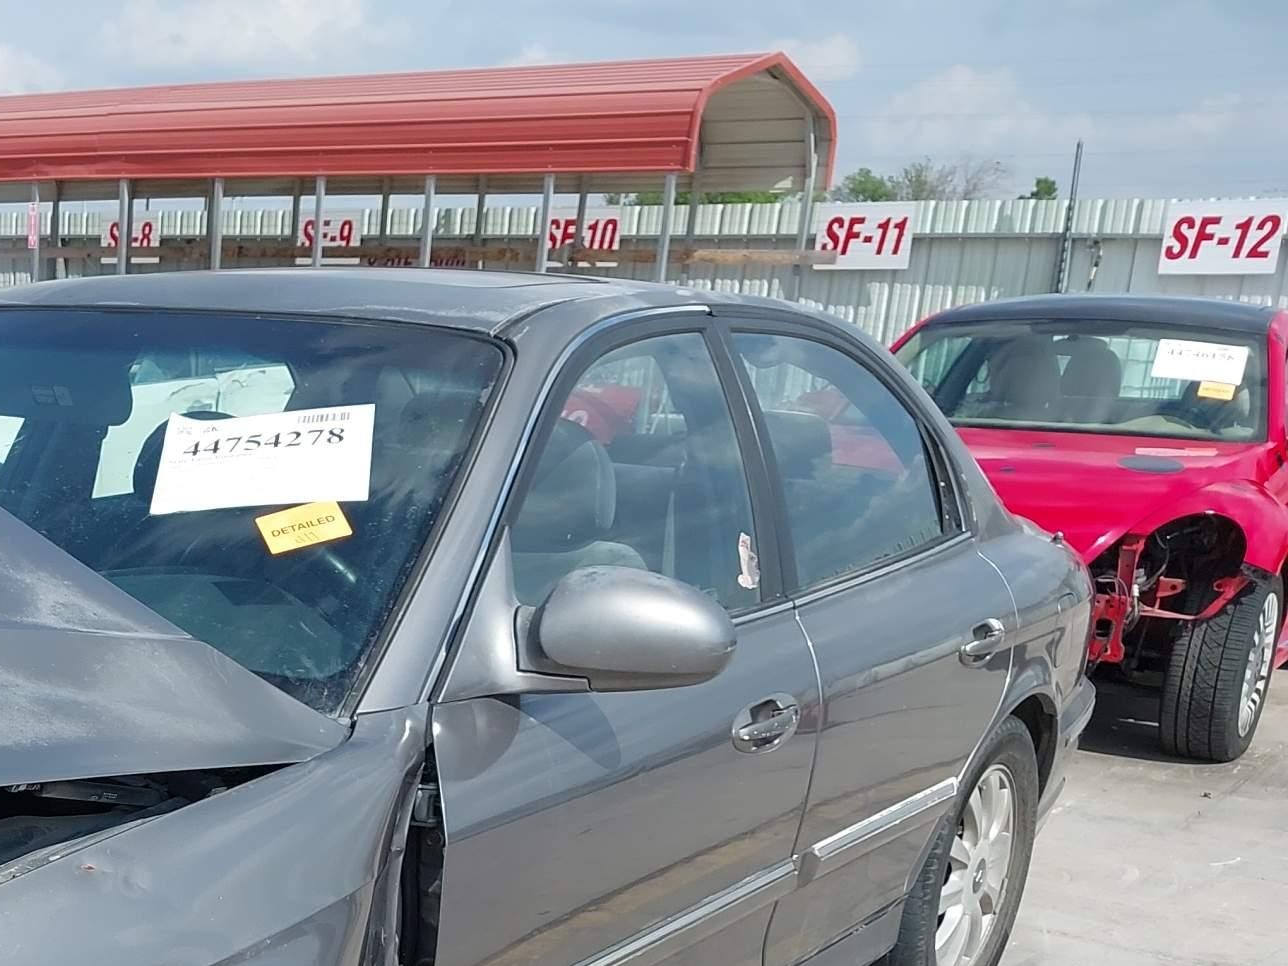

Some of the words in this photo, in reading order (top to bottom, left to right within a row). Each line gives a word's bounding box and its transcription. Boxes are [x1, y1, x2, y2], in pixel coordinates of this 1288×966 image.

[107, 221, 152, 247] S-8
[549, 218, 618, 249] SF10
[821, 216, 908, 255] SF-11
[1164, 214, 1282, 260] SF-12
[184, 427, 345, 456] 44754278
[271, 515, 335, 537] DETAILED
